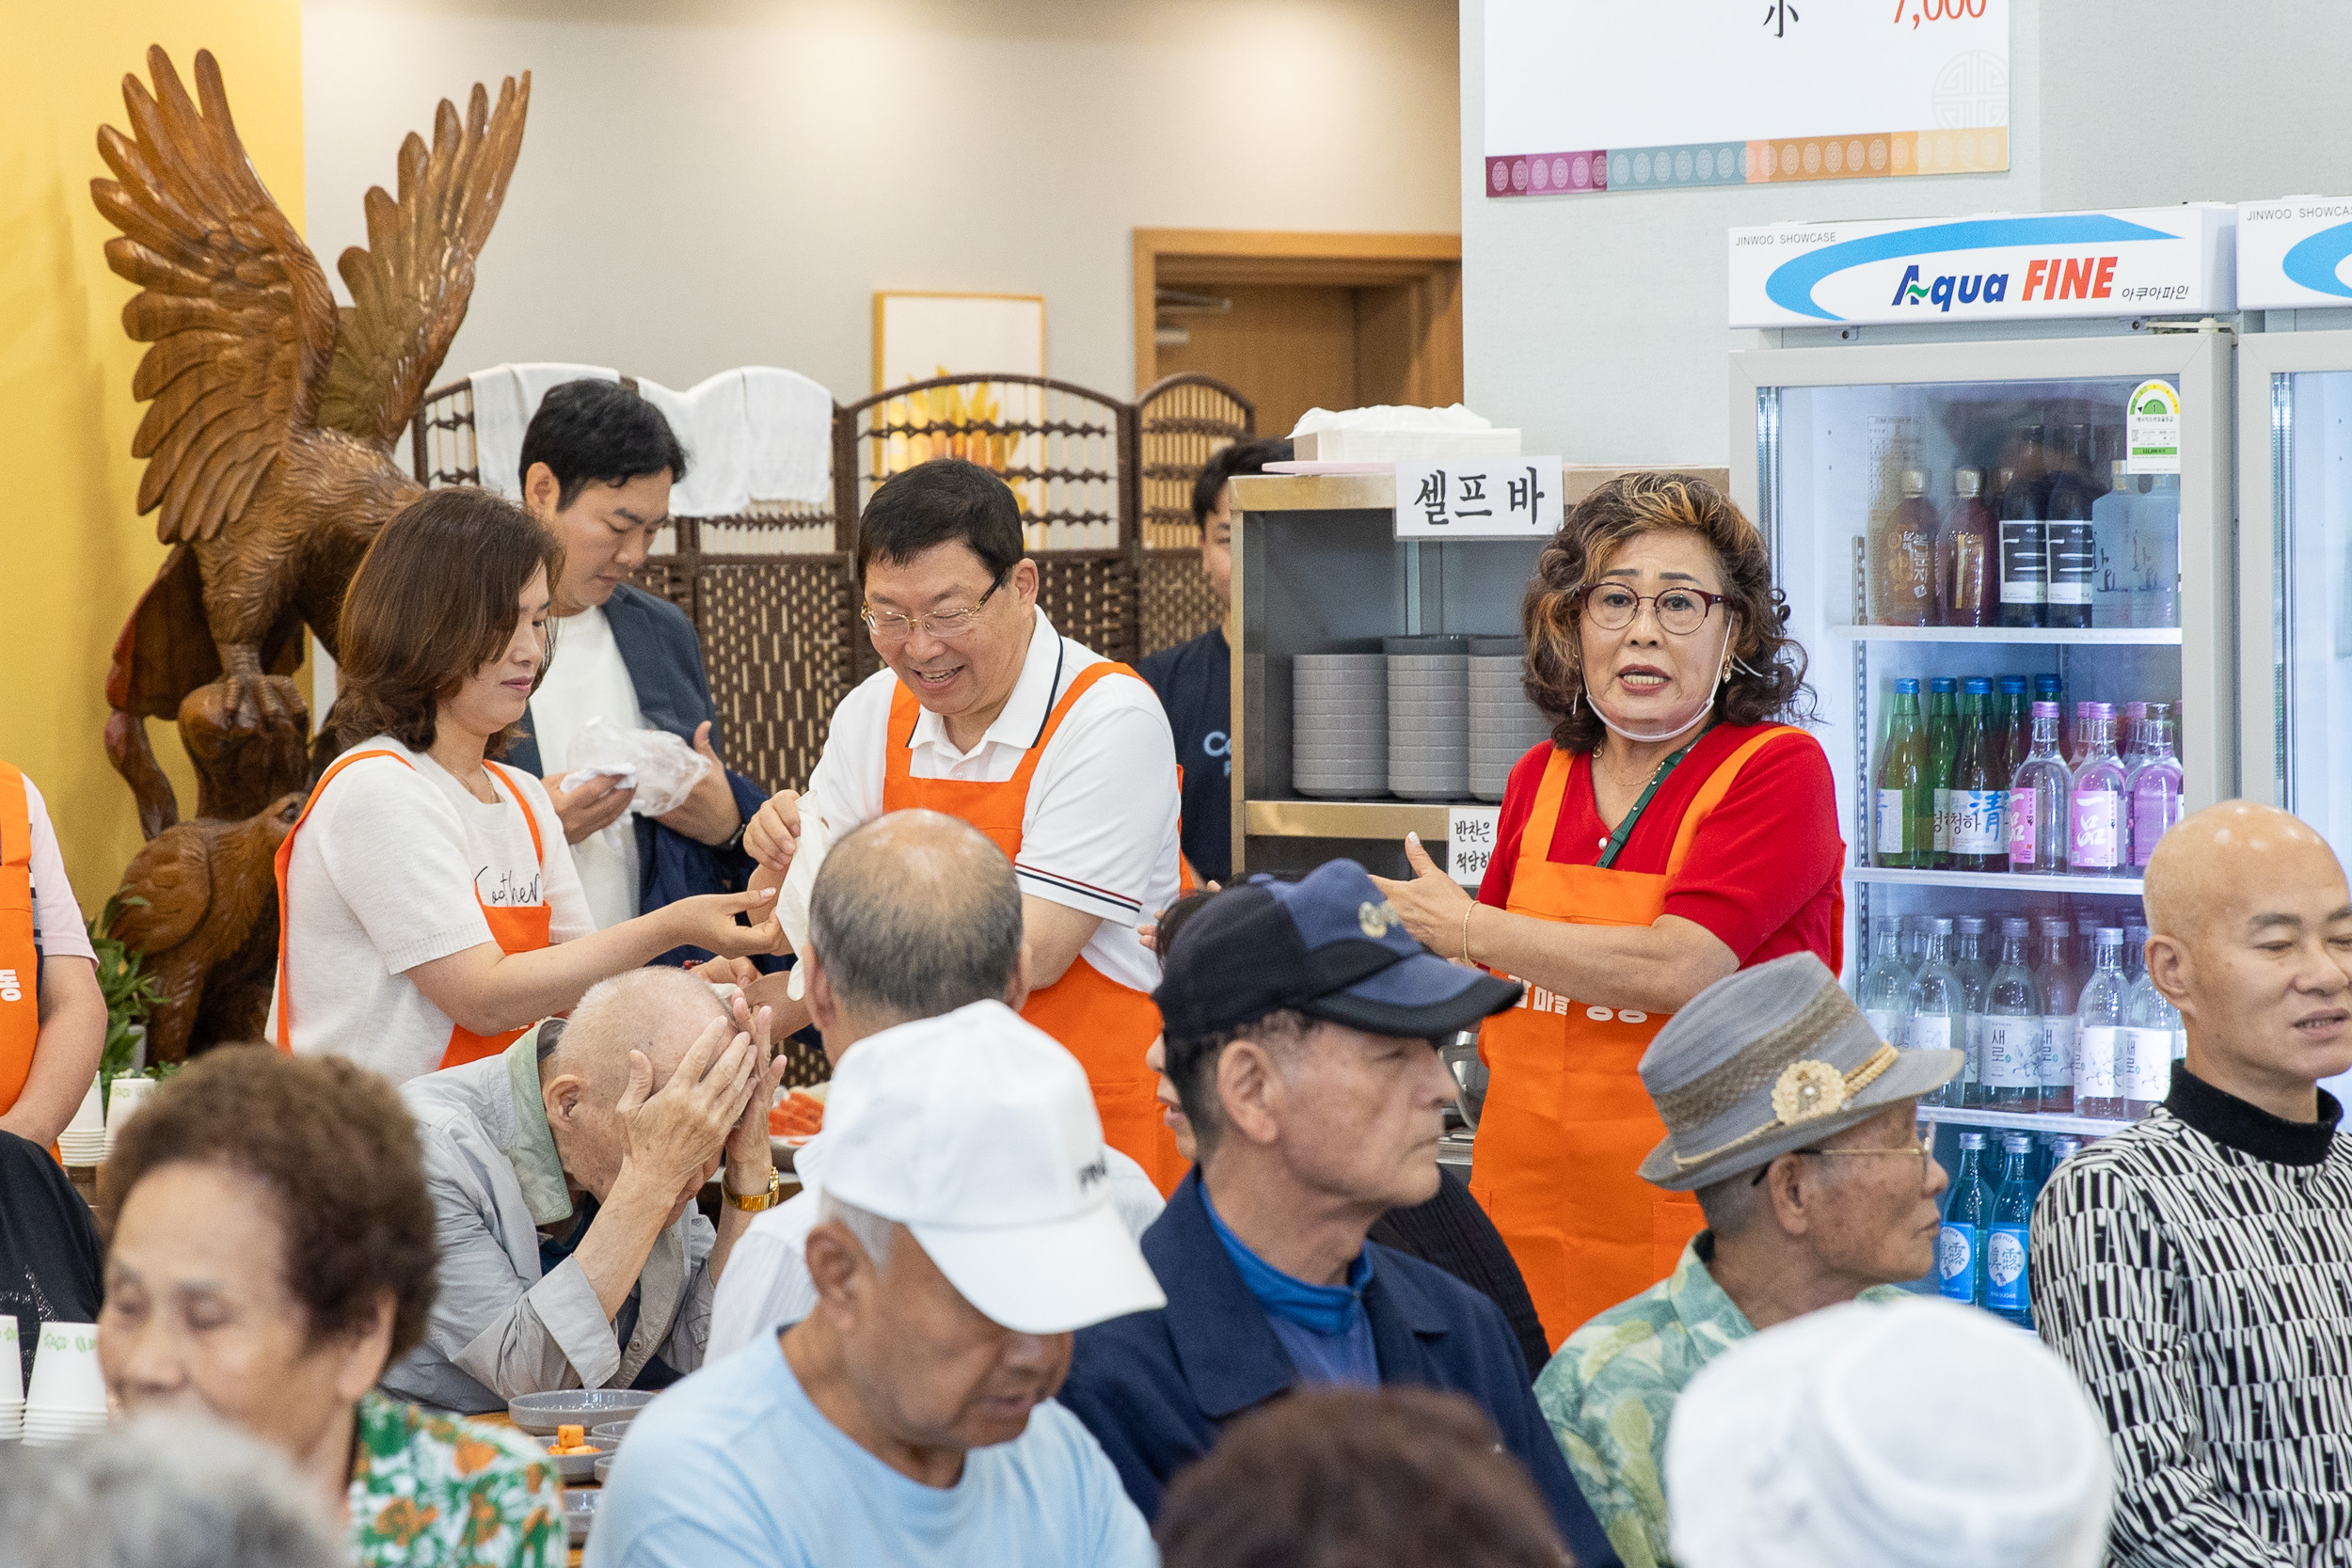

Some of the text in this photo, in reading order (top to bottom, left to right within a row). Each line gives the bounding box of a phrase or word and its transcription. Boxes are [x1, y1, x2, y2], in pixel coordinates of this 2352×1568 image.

[1762, 0, 1799, 38] 小
[2247, 208, 2292, 221] JINWOO
[1736, 231, 1836, 246] JINWOO SHOWCASE
[1891, 256, 2119, 312] Aqua FINE
[2122, 284, 2189, 301] 아쿠아파인
[1414, 466, 1545, 526] 셀프 바
[1454, 819, 1490, 843] 반찬은
[1949, 811, 1982, 835] 청하
[1992, 1029, 2005, 1062] 새로
